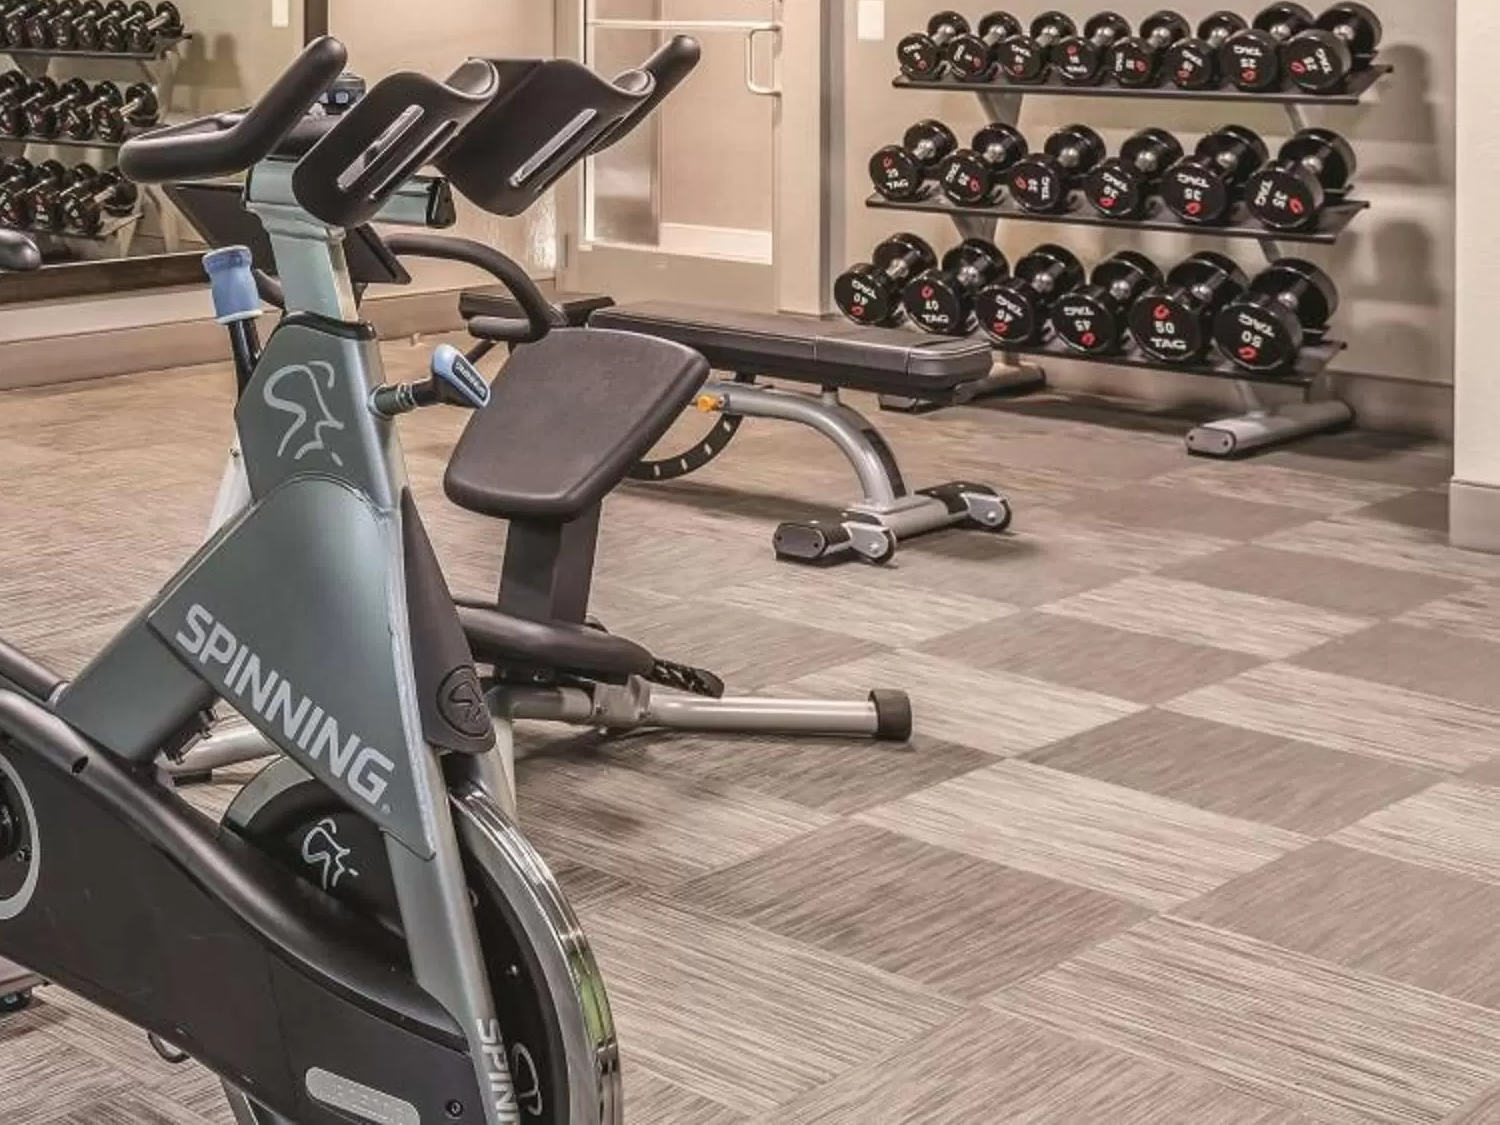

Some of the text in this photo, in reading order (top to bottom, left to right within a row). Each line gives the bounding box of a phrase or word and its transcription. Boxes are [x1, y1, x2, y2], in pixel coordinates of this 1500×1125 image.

[885, 179, 909, 190] TAG
[1254, 179, 1274, 207] TAG
[1063, 306, 1095, 317] TAG
[921, 313, 949, 324] TAG
[1237, 312, 1276, 339] TAG
[1149, 337, 1187, 351] TAG
